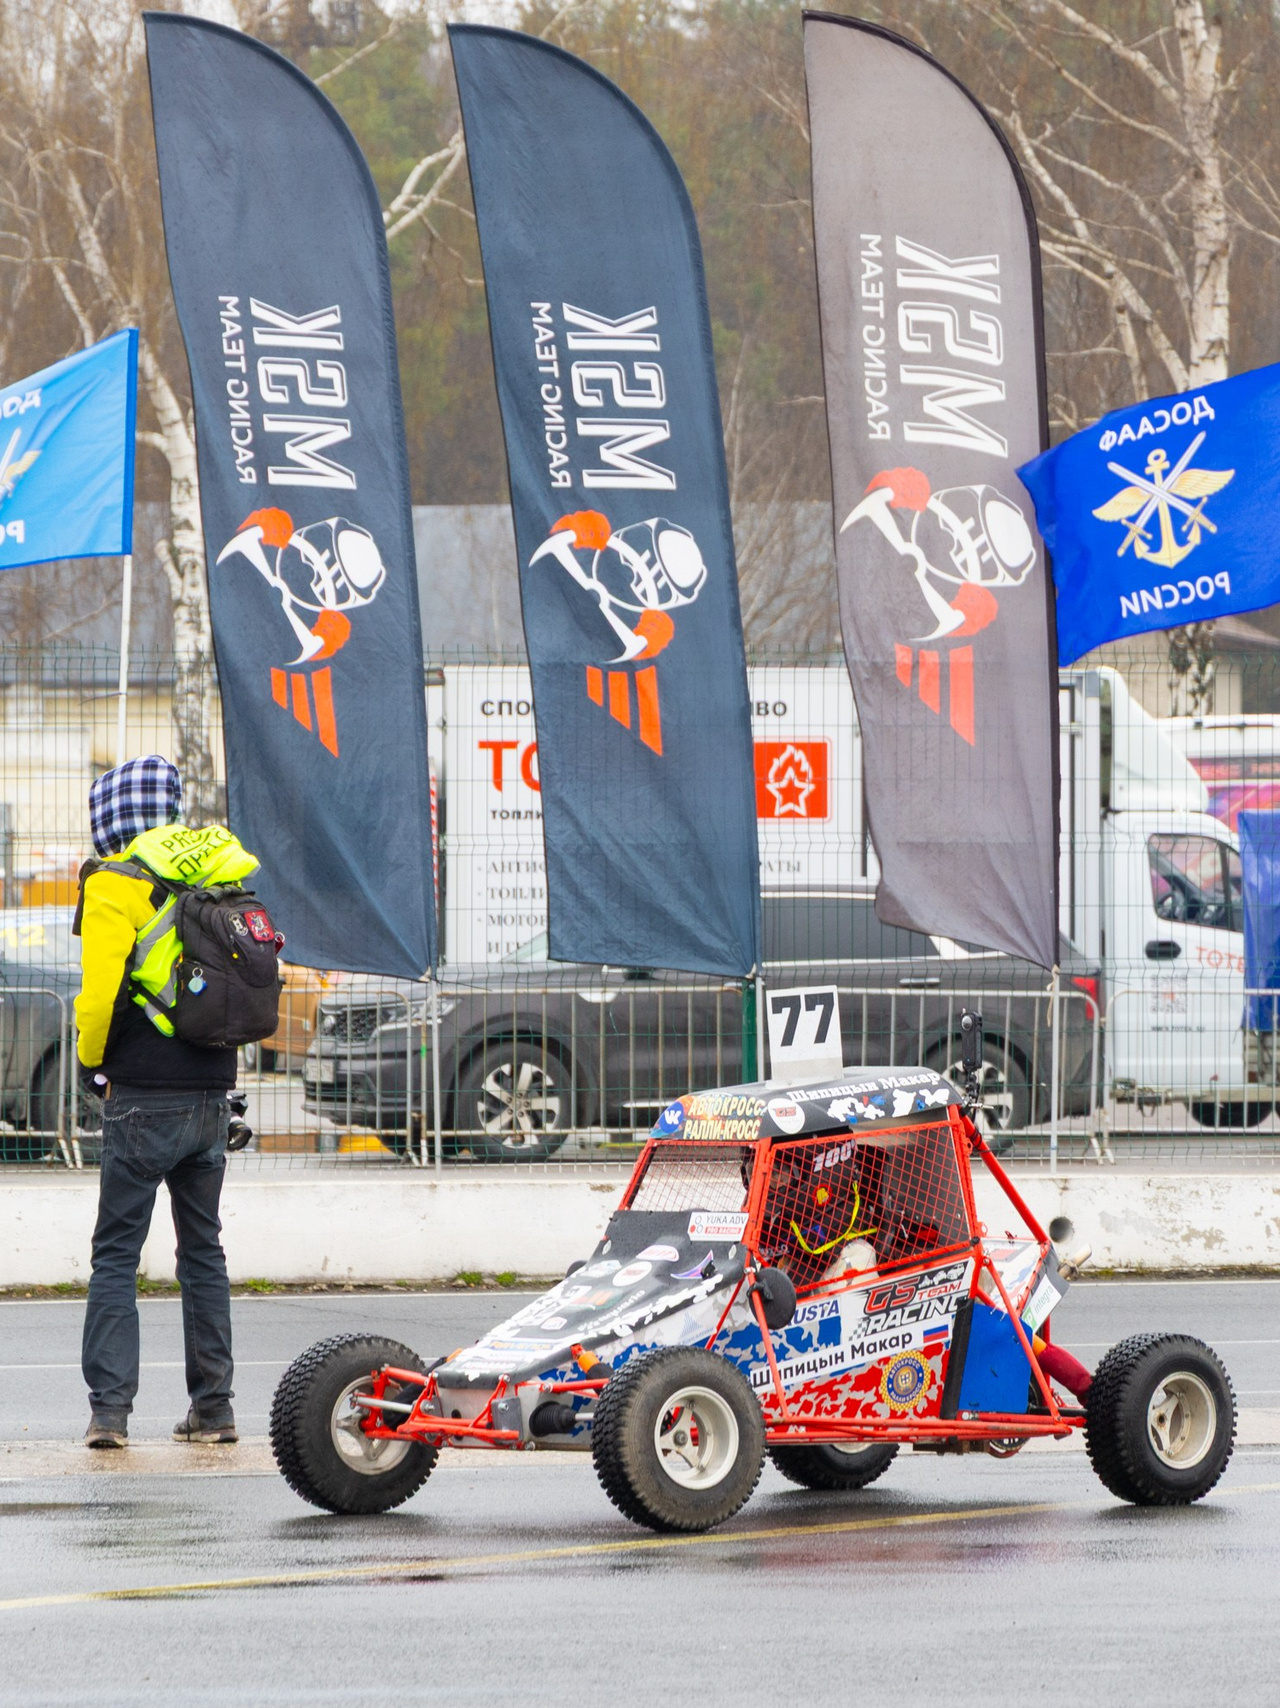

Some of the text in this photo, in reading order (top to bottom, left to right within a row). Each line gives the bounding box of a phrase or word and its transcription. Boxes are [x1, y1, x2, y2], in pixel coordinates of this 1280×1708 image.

[751, 701, 788, 717] ВО
[771, 992, 835, 1047] 77
[878, 1072, 941, 1090] Макар
[687, 1096, 764, 1117] АВТОКРОСС
[683, 1119, 761, 1140] РАЛЛИ-КРОСС
[706, 1215, 728, 1224] YUKA
[865, 1276, 962, 1315] GS TEAM
[788, 1299, 840, 1326] USTA
[851, 1332, 913, 1358] Макар
